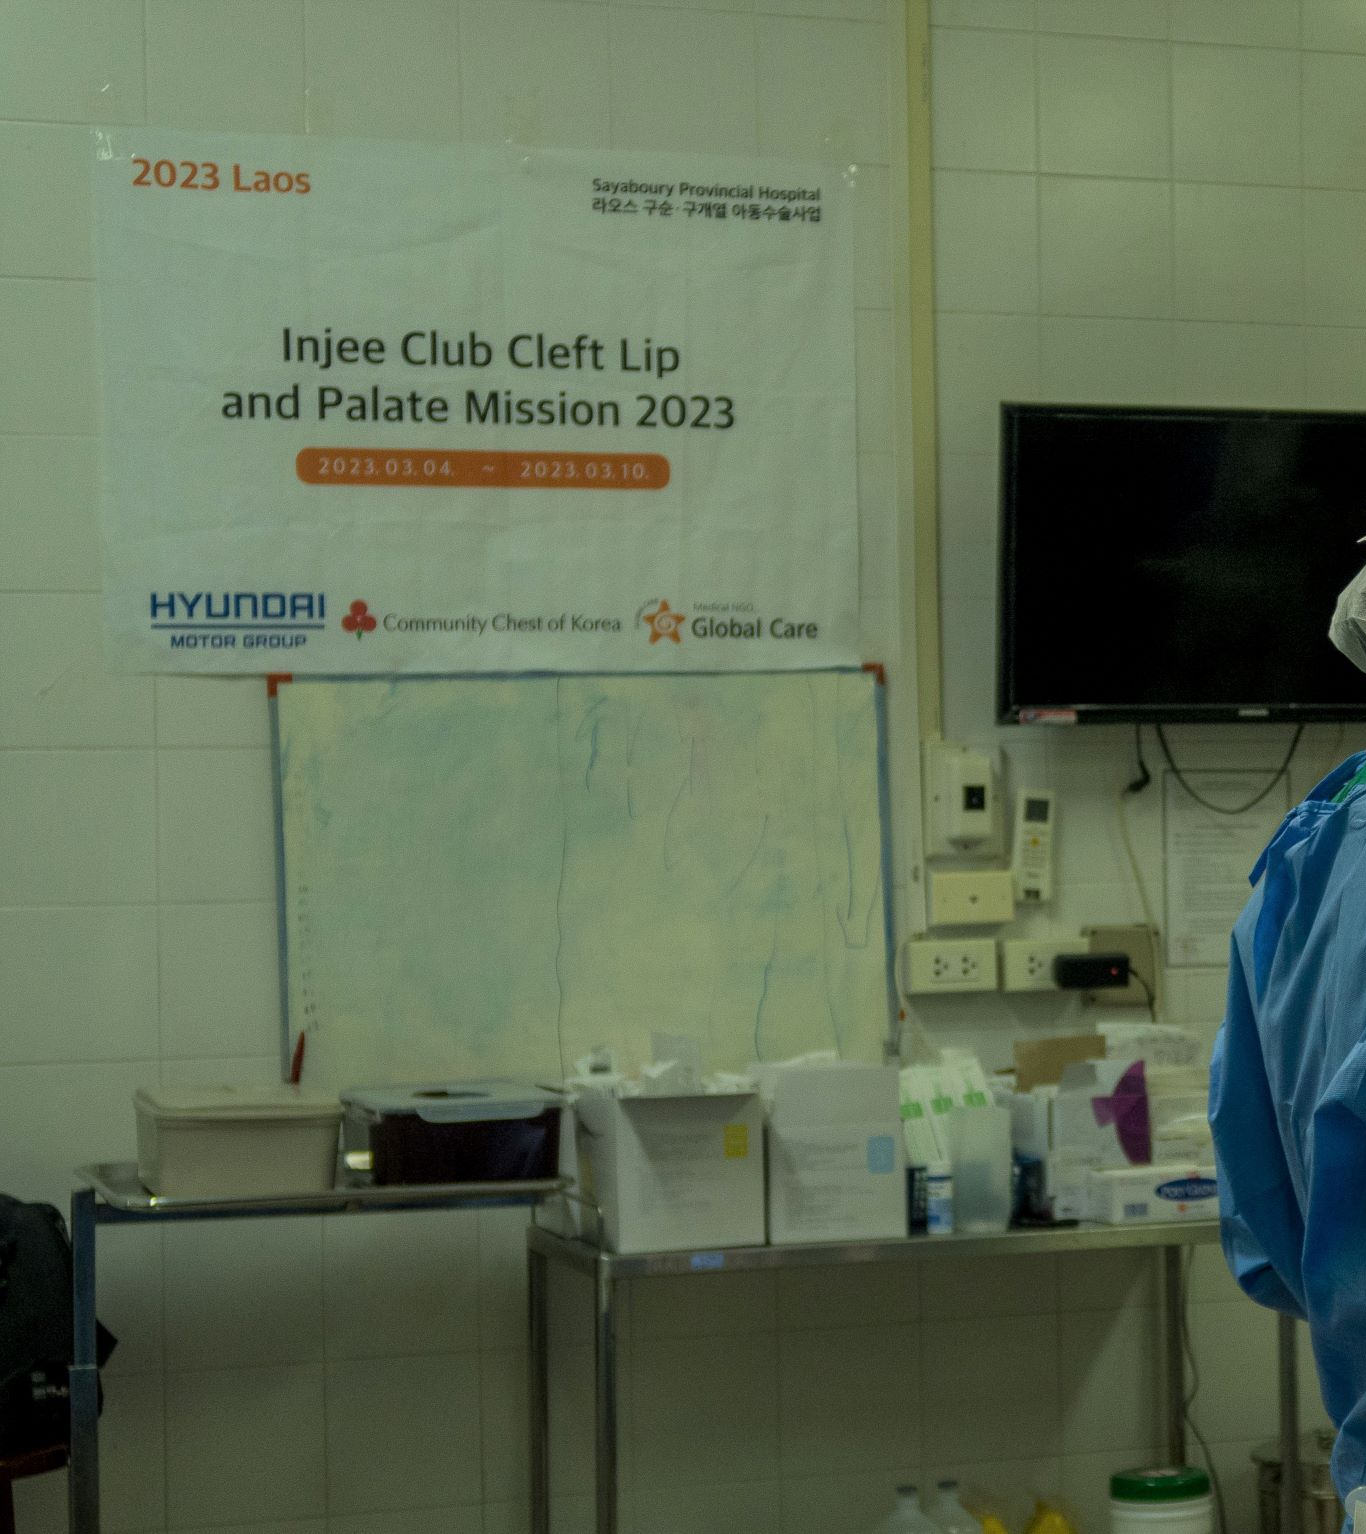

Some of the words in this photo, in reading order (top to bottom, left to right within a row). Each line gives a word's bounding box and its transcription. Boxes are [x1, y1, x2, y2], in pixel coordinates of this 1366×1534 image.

[132, 158, 220, 190] 2023
[232, 163, 311, 195] Laos
[592, 178, 675, 195] Sayaboury
[679, 182, 753, 199] Provincial
[758, 186, 821, 204] Hospital
[592, 197, 638, 214] 라오스
[283, 328, 386, 369] Injee
[401, 330, 493, 367] Club
[508, 333, 605, 371] Cleft
[620, 338, 681, 379] Lip
[221, 384, 300, 420] and
[318, 385, 449, 423] Palate
[465, 390, 621, 427] Mission
[636, 394, 736, 430] 2023
[150, 592, 326, 619] HYUNDAI
[382, 612, 488, 635] Community
[492, 613, 547, 632] Chest
[549, 613, 567, 632] of
[571, 614, 622, 633] Korea
[691, 616, 762, 639] Global
[769, 618, 819, 640] Care
[170, 634, 237, 649] MOTOR
[243, 634, 308, 649] GROUP
